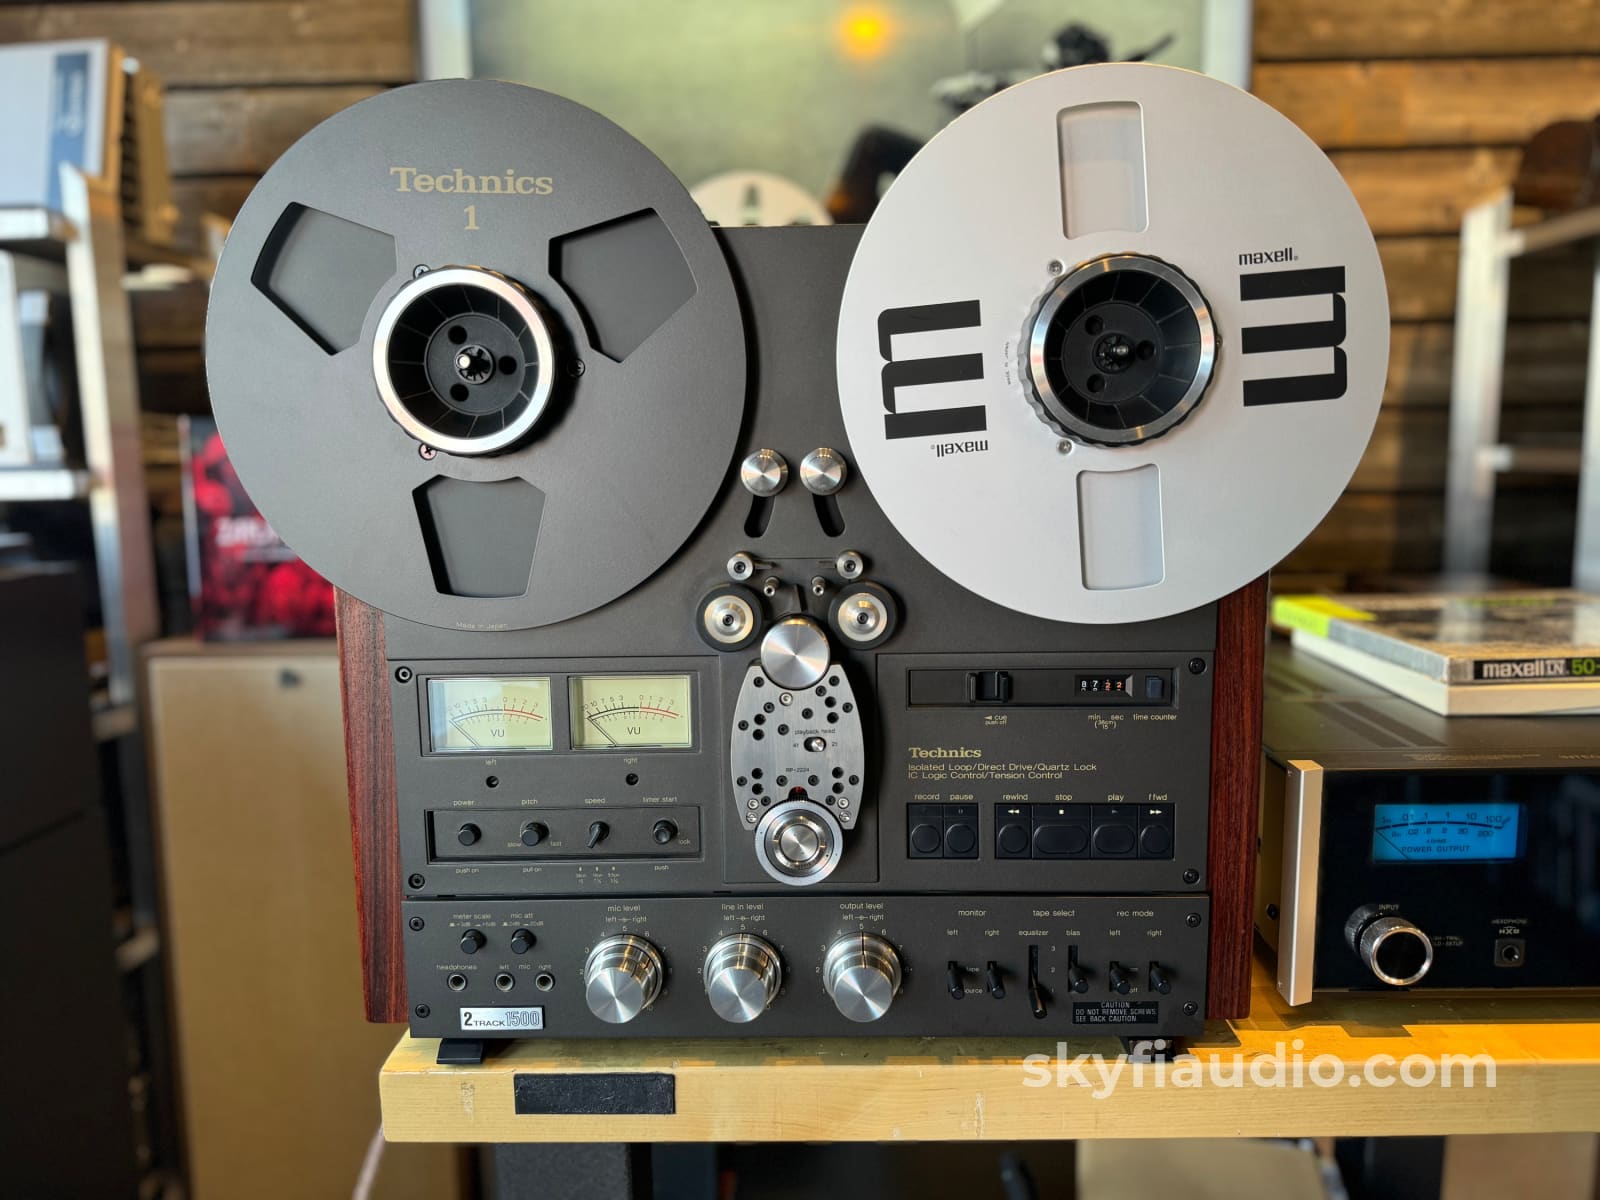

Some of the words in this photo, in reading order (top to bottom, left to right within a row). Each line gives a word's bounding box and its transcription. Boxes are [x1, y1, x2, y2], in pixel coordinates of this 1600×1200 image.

[389, 167, 553, 195] Technics
[463, 204, 480, 231] 1
[1238, 247, 1293, 266] maxell
[935, 439, 989, 458] maxell
[1483, 659, 1545, 678] maxell
[1087, 713, 1101, 721] min
[1132, 713, 1149, 721] time
[490, 728, 505, 738] VU
[626, 726, 641, 735] VU
[908, 746, 983, 759] Technics
[623, 756, 638, 766] right
[908, 763, 945, 772] Isolated
[948, 763, 1006, 774] Loop/Direct
[1008, 763, 1070, 772] Drive/Quartz
[1073, 763, 1097, 772] Lock
[908, 772, 919, 780] IC
[921, 772, 948, 781] Logic
[950, 772, 1025, 780] Control/Tension
[1027, 772, 1063, 780] Control
[584, 797, 606, 805] speed
[914, 793, 941, 801] record
[949, 794, 974, 802] pause
[1055, 793, 1073, 802] stop
[1107, 793, 1125, 803] play
[453, 799, 476, 807] power
[521, 798, 538, 806] pitch
[1401, 845, 1433, 854] POWER
[1436, 845, 1471, 853] OUTPUT
[455, 867, 471, 875] push
[654, 864, 670, 872] push
[607, 904, 622, 912] mic
[623, 904, 641, 912] level
[721, 903, 735, 911] line
[746, 903, 764, 911] level
[840, 902, 864, 910] output
[865, 902, 884, 910] level
[1378, 903, 1400, 911] INPUT
[452, 913, 473, 921] meter
[523, 911, 534, 919] att
[958, 909, 987, 917] monitor
[1032, 909, 1050, 918] tape
[1052, 909, 1076, 918] select
[1116, 910, 1130, 918] rec
[1132, 909, 1154, 918] mode
[632, 916, 647, 924] right
[750, 914, 766, 923] right
[869, 913, 884, 922] right
[946, 929, 959, 937] left
[984, 929, 1000, 938] right
[1018, 929, 1049, 938] equalizer
[1065, 929, 1081, 937] bias
[1109, 929, 1121, 937] left
[1146, 929, 1162, 938] right
[436, 963, 478, 971] headphones
[538, 963, 552, 971] right
[1100, 1001, 1130, 1009] CAUTION
[1108, 1015, 1138, 1023] CAUTION
